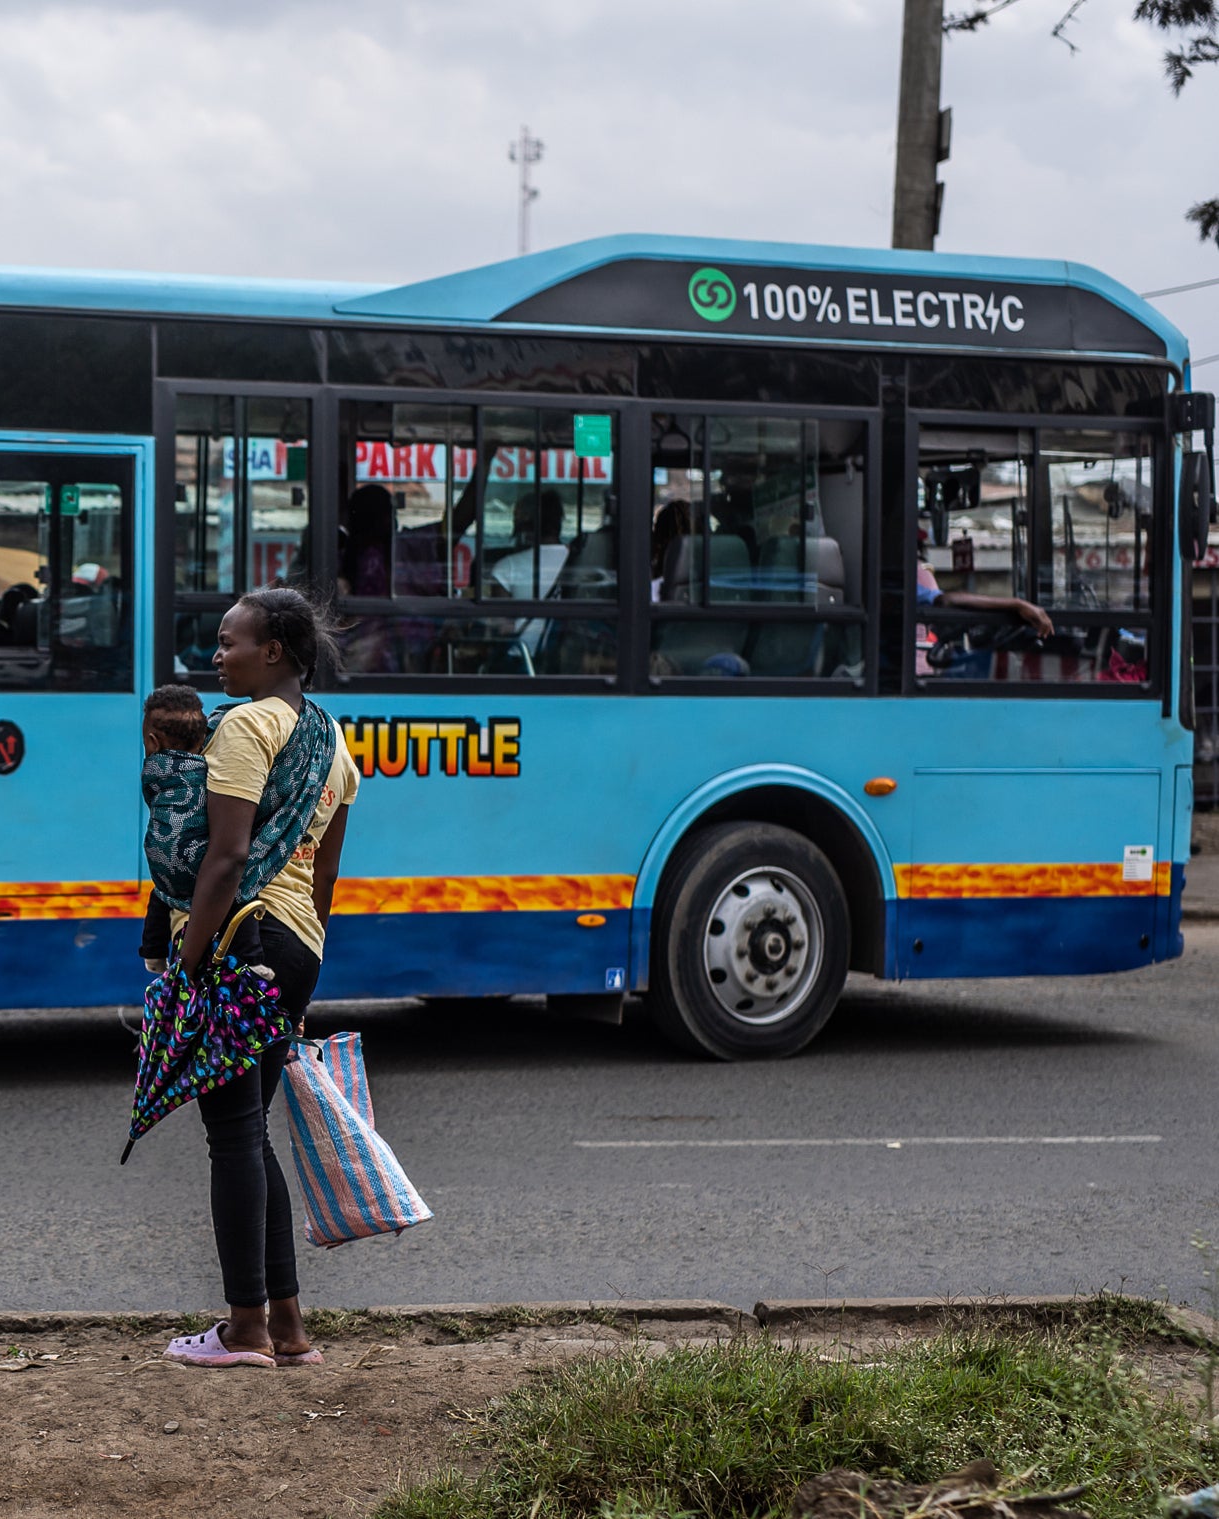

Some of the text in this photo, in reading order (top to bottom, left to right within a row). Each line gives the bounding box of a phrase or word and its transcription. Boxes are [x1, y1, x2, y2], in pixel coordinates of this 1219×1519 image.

[743, 282, 842, 323] 100%
[356, 441, 607, 478] PARK HSPITAL
[342, 719, 521, 778] HUTTLE
